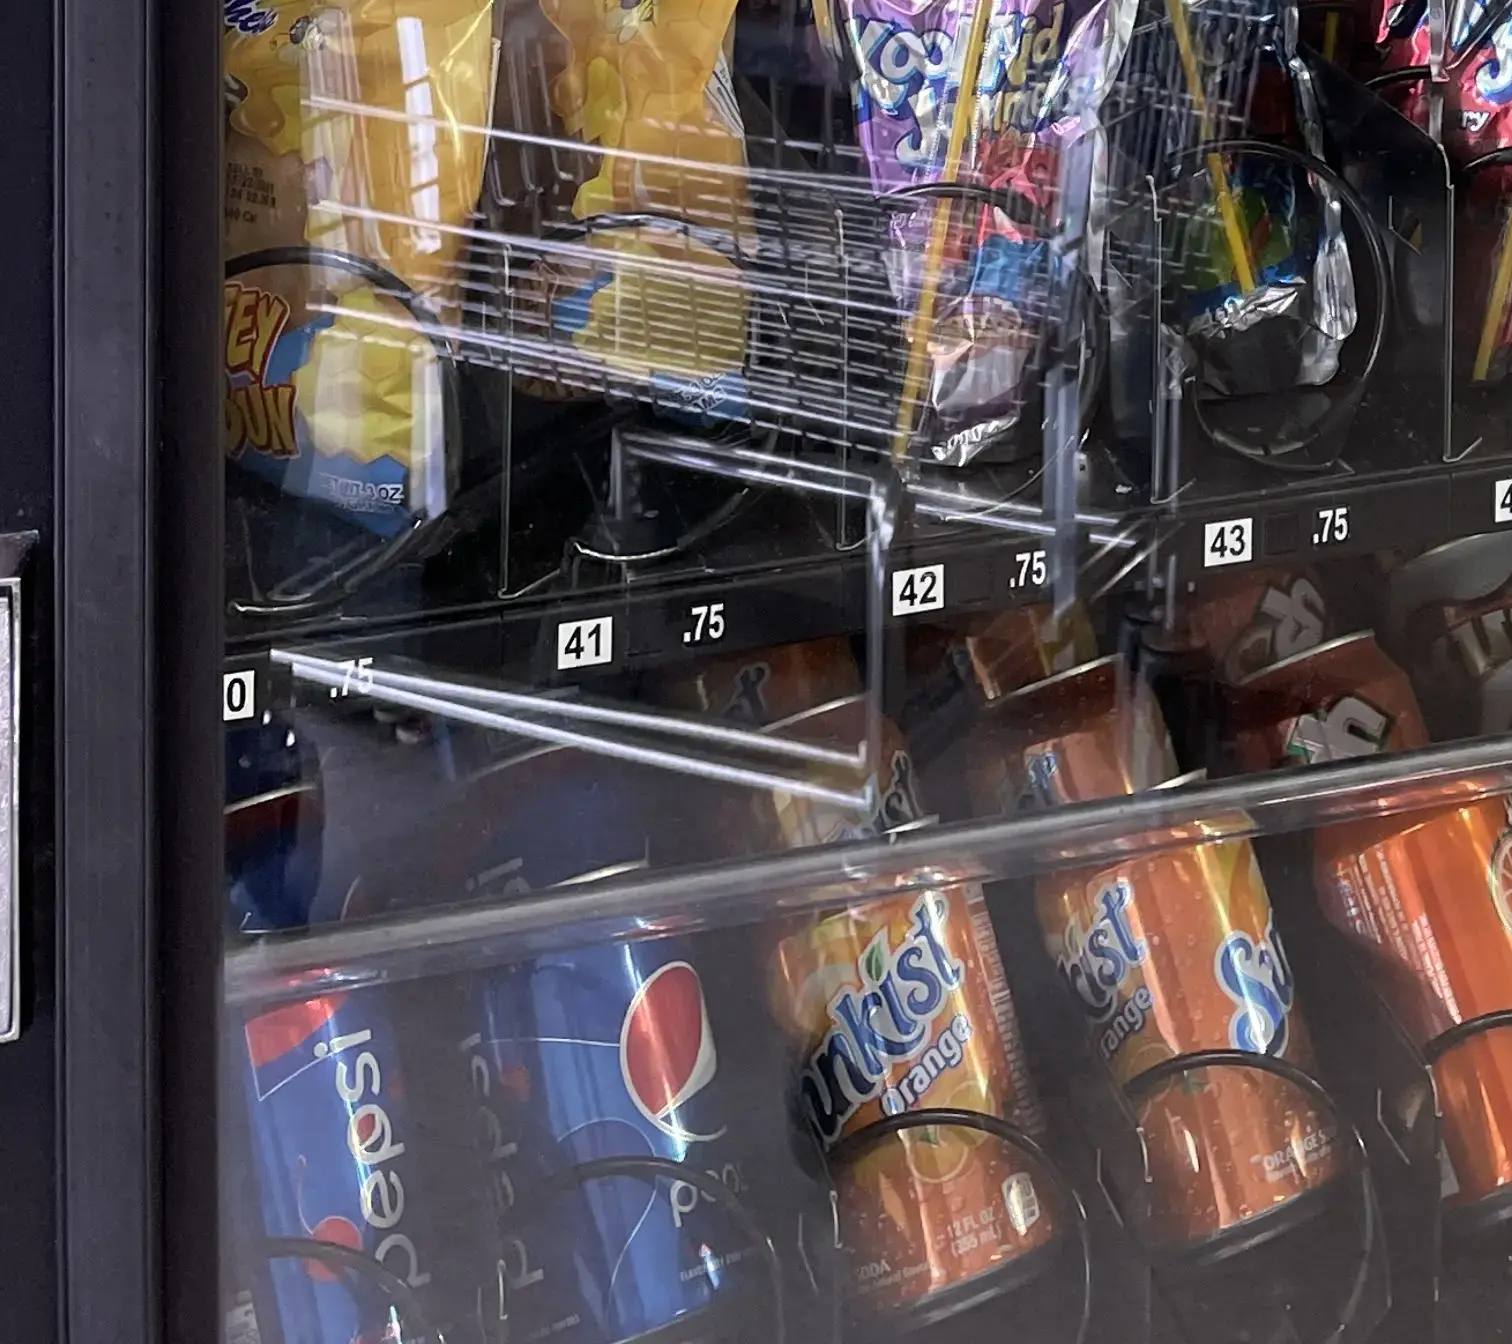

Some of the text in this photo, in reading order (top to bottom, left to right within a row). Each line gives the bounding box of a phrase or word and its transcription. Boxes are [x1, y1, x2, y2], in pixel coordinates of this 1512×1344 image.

[1211, 525, 1244, 558] 43
[1313, 508, 1349, 544] .75
[1009, 552, 1046, 588] .75
[900, 574, 936, 605] 42
[683, 603, 725, 644] .75
[565, 625, 601, 661] 41
[226, 678, 246, 713] 0
[800, 895, 962, 1140] unkist
[882, 1014, 973, 1114] orange
[313, 1029, 431, 1287] pepsi
